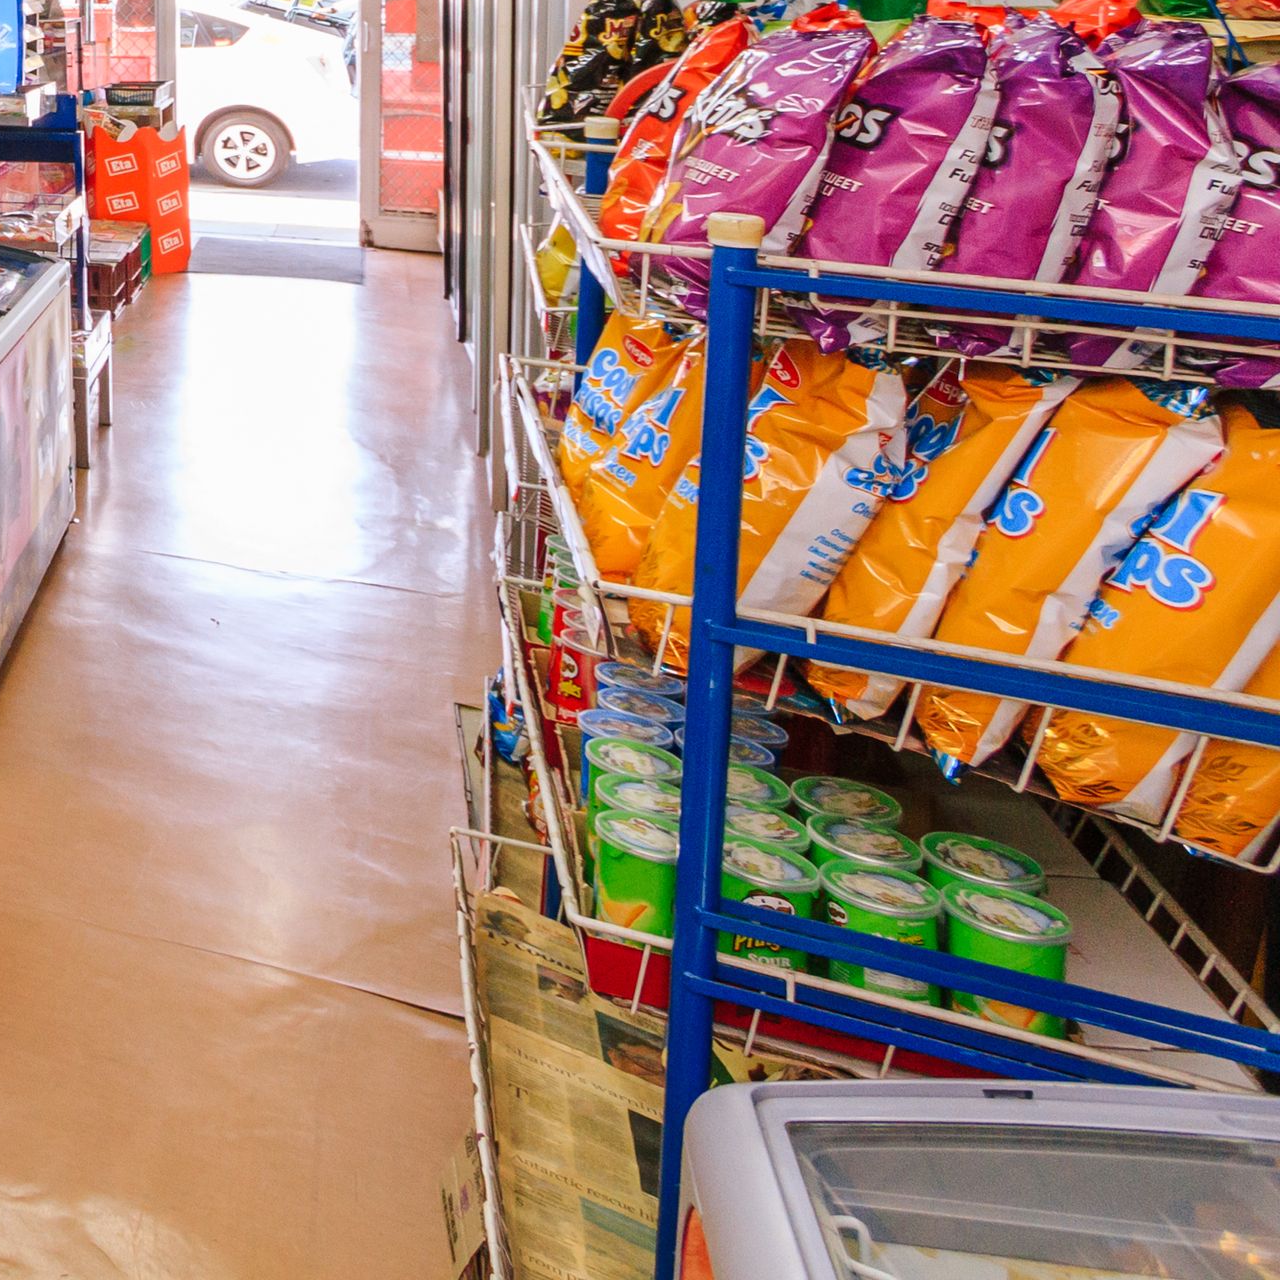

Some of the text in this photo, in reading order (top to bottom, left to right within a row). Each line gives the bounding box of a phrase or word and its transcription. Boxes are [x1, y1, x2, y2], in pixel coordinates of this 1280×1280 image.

[110, 159, 133, 171] Eta
[160, 158, 178, 170] Eta
[111, 198, 134, 209] Eta
[161, 198, 179, 209] Eta
[162, 236, 180, 248] Eta
[748, 952, 791, 968] SOUR
[514, 1153, 638, 1214] Antarctic rescue
